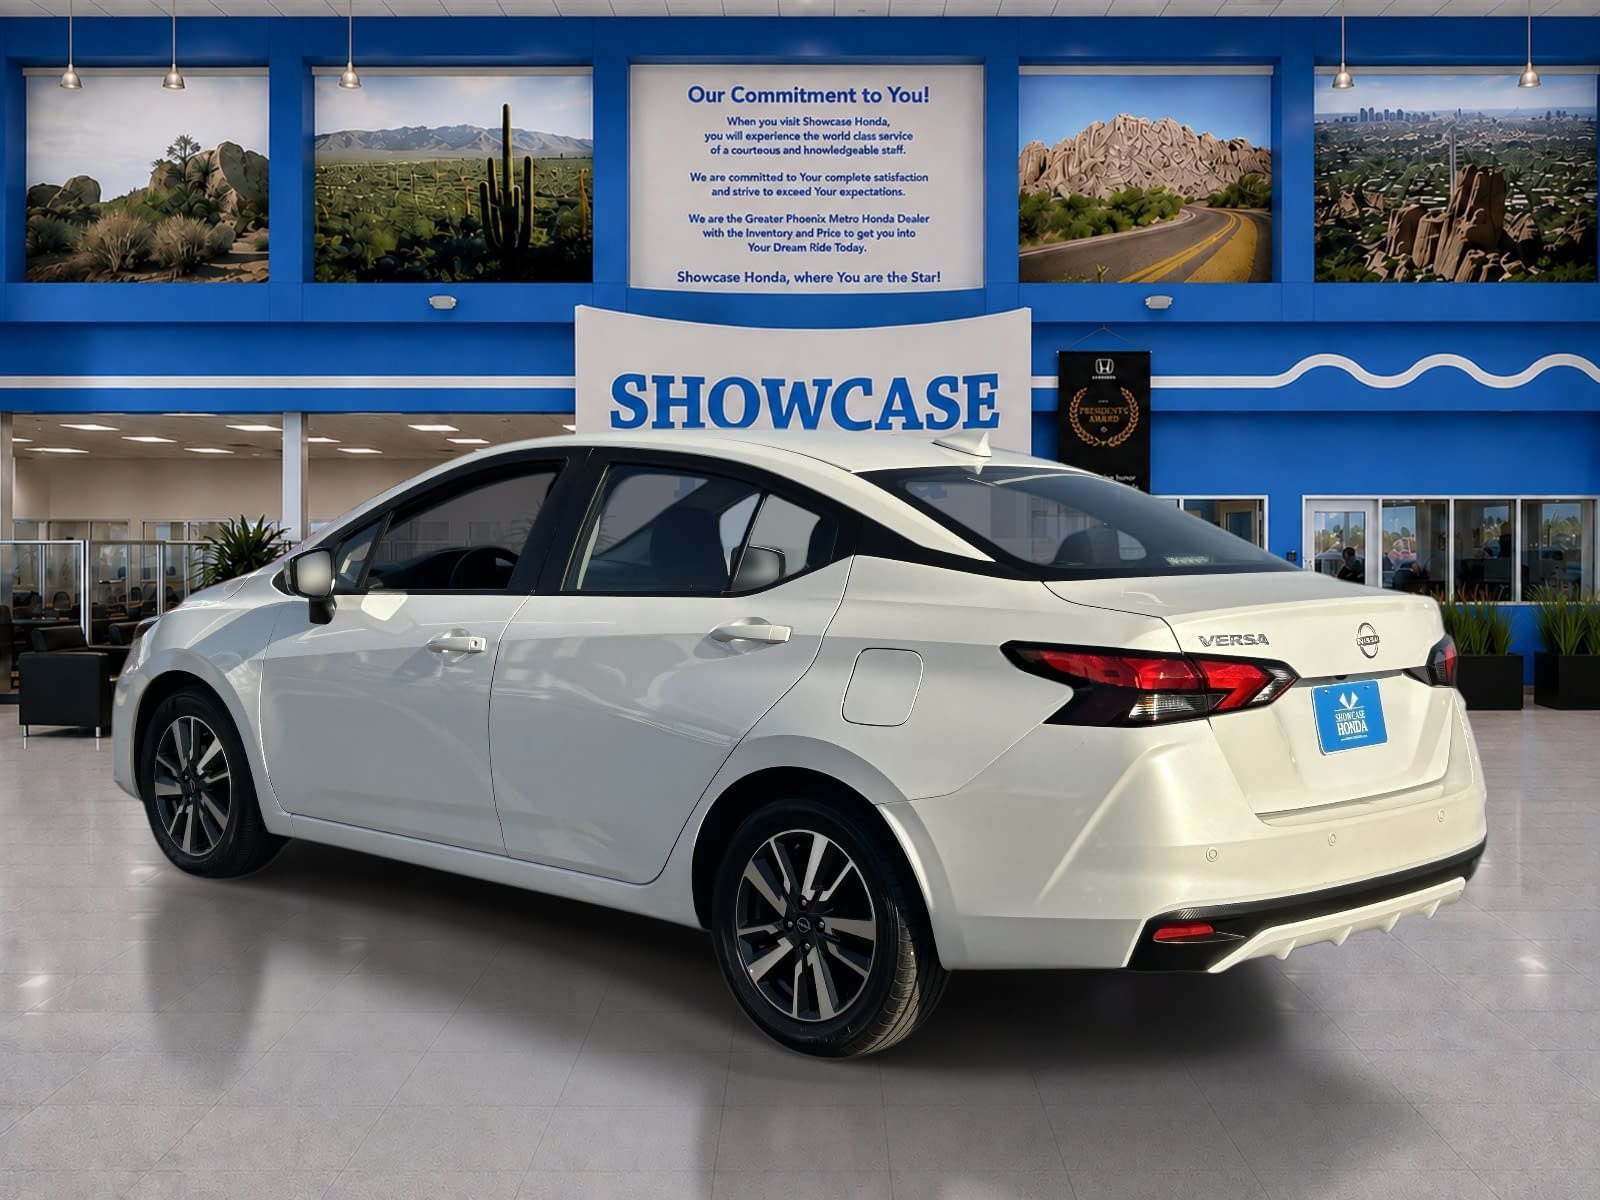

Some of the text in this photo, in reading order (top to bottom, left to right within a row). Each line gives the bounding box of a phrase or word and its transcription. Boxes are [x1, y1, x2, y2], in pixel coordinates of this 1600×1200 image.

[687, 85, 930, 104] Our Commitment to You!
[726, 116, 891, 129] When you visit Showcase Honda,
[704, 130, 914, 144] you will experience the world class service
[710, 144, 721, 155] of
[722, 146, 729, 155] a
[730, 145, 781, 155] courteous
[782, 144, 802, 155] and
[881, 144, 906, 155] staff.
[689, 171, 929, 185] We are committed to Your complete satisfaction
[711, 186, 906, 200] and strive to exceed Your expectations.
[688, 213, 931, 224] We are the Greater Phoenix Metro Honda Dealer
[702, 227, 917, 241] with the Inventory and Price to get you into
[747, 242, 867, 255] Your Dream Ride Today.
[677, 270, 941, 286] Showcase Honda, where You are the Star!
[610, 373, 1000, 430] SHOWCASE
[1198, 633, 1269, 647] VERSA
[1336, 710, 1365, 722] SHOWCASE
[1337, 720, 1368, 736] HONDA
